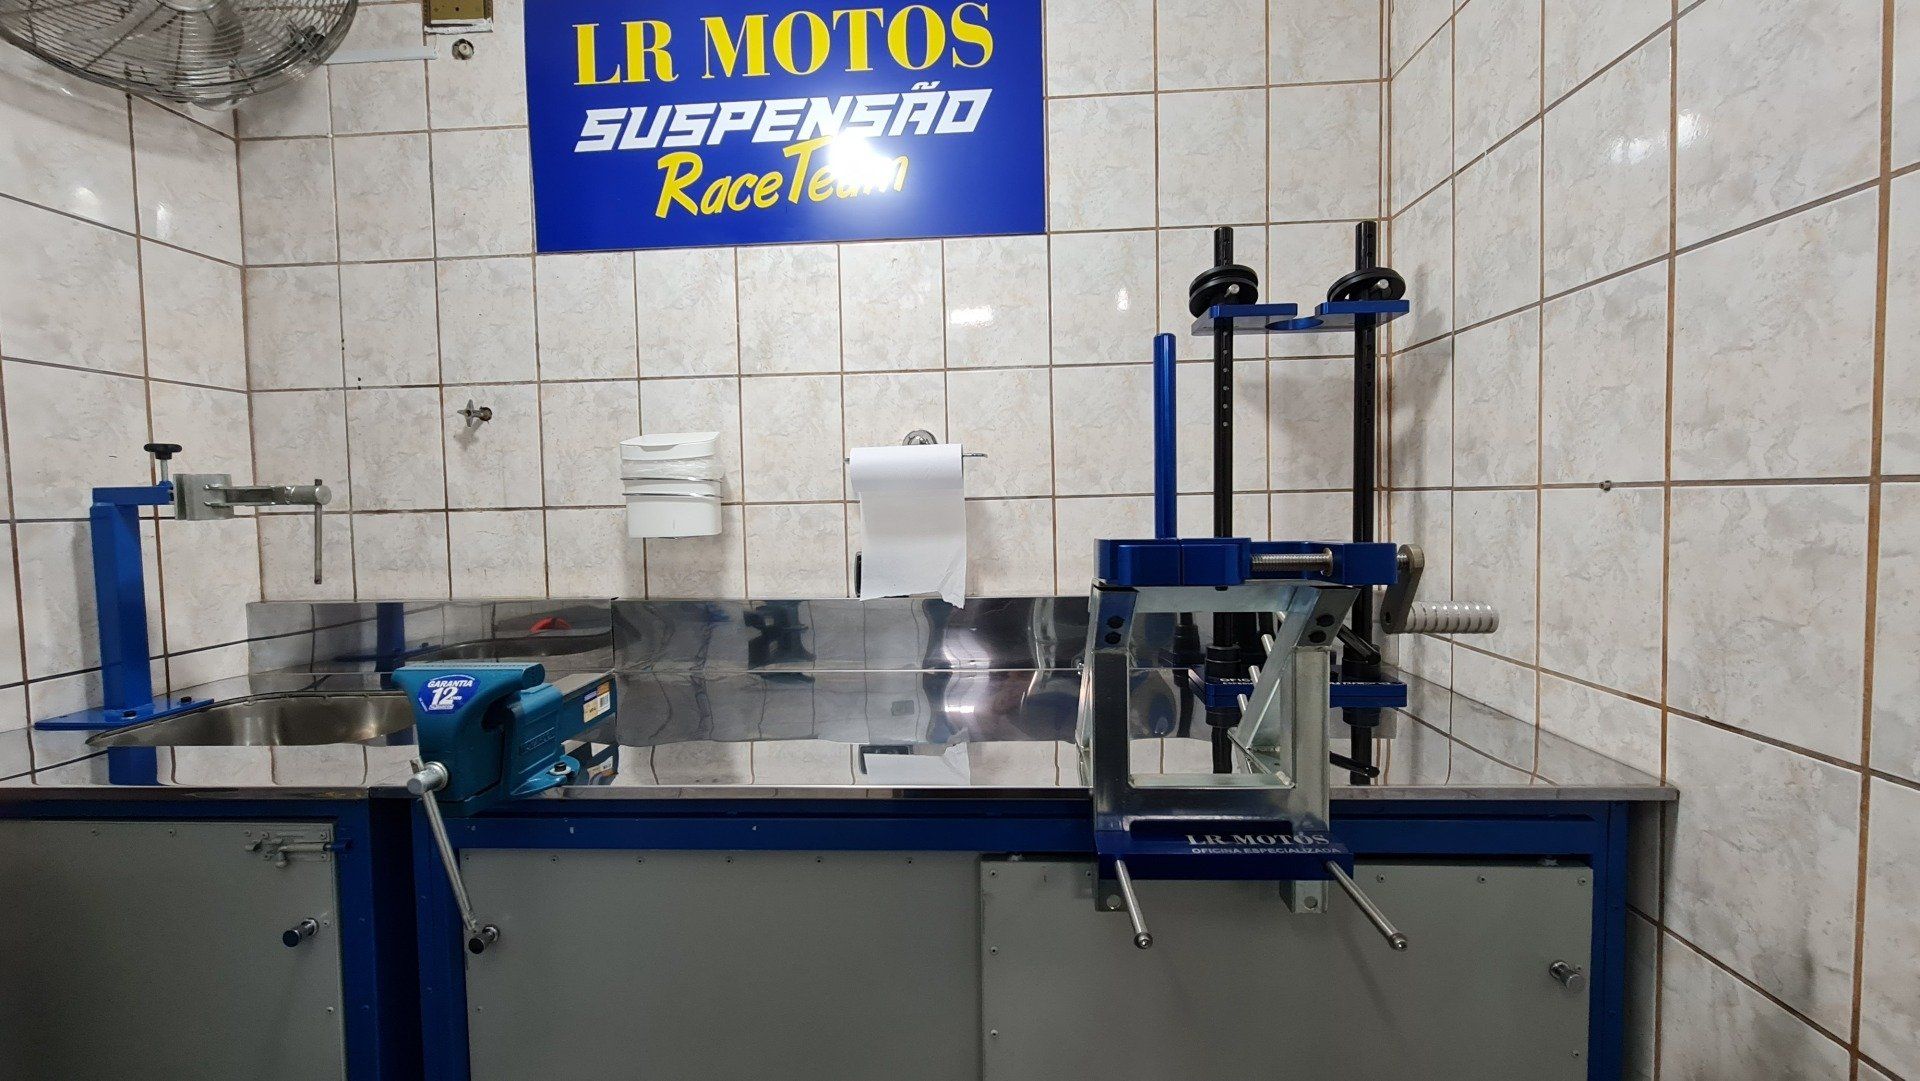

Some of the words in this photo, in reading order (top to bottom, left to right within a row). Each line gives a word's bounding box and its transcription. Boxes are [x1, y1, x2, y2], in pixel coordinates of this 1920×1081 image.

[572, 20, 679, 86] LR
[701, 2, 994, 79] MOTOS
[574, 81, 993, 153] SUSPENSÃO
[427, 680, 474, 688] GARANTIA
[432, 686, 459, 706] 12
[1185, 834, 1229, 845] LR
[1230, 833, 1330, 845] MOTOS
